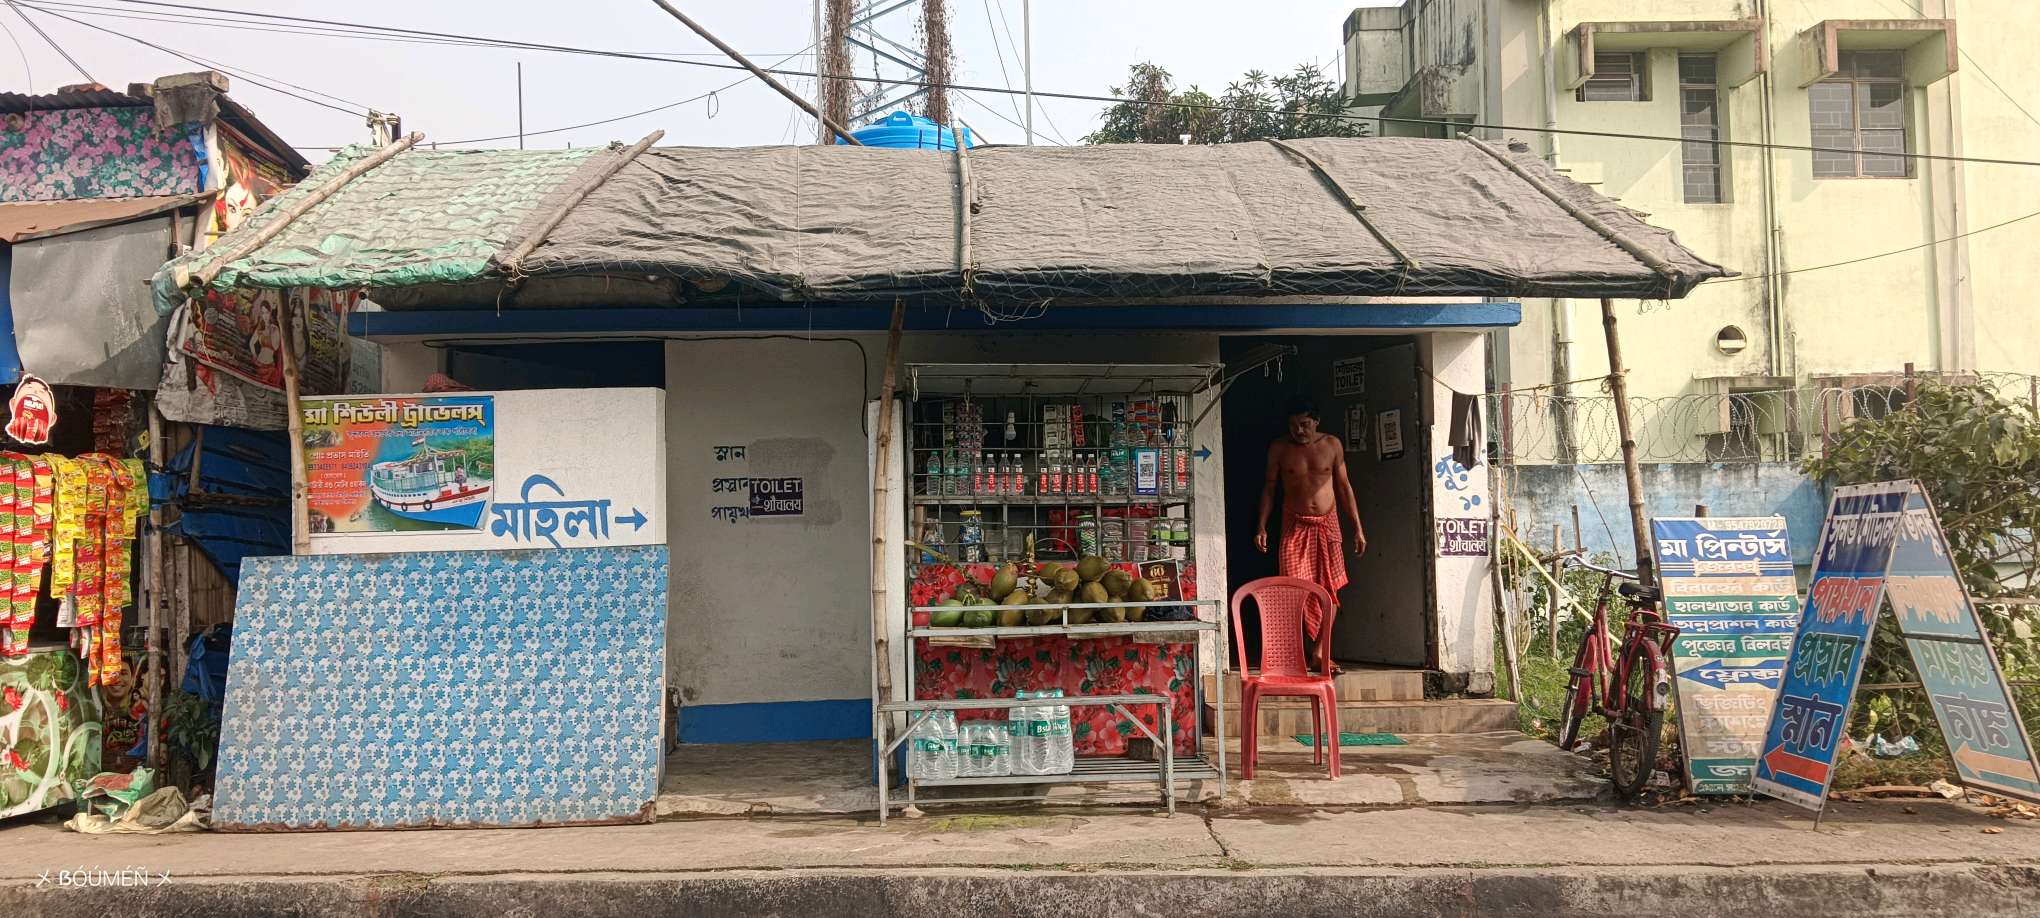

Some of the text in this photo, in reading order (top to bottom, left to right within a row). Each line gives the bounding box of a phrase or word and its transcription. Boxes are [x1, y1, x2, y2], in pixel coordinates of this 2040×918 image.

[302, 407, 329, 426] মা
[332, 401, 399, 426] শিউলী
[751, 480, 802, 494] TOILET
[491, 474, 611, 549] মহিলা
[763, 495, 801, 513] शौचालय
[711, 506, 750, 524] পায়খ
[1440, 520, 1486, 534] TOILET
[1658, 529, 1787, 560] মা প্রিন্টার্স
[1674, 597, 1791, 613] হালখাতার কার্ড
[1673, 615, 1797, 632] অন্নপ্রাশন কার্ড
[1781, 693, 1844, 753] স্নান
